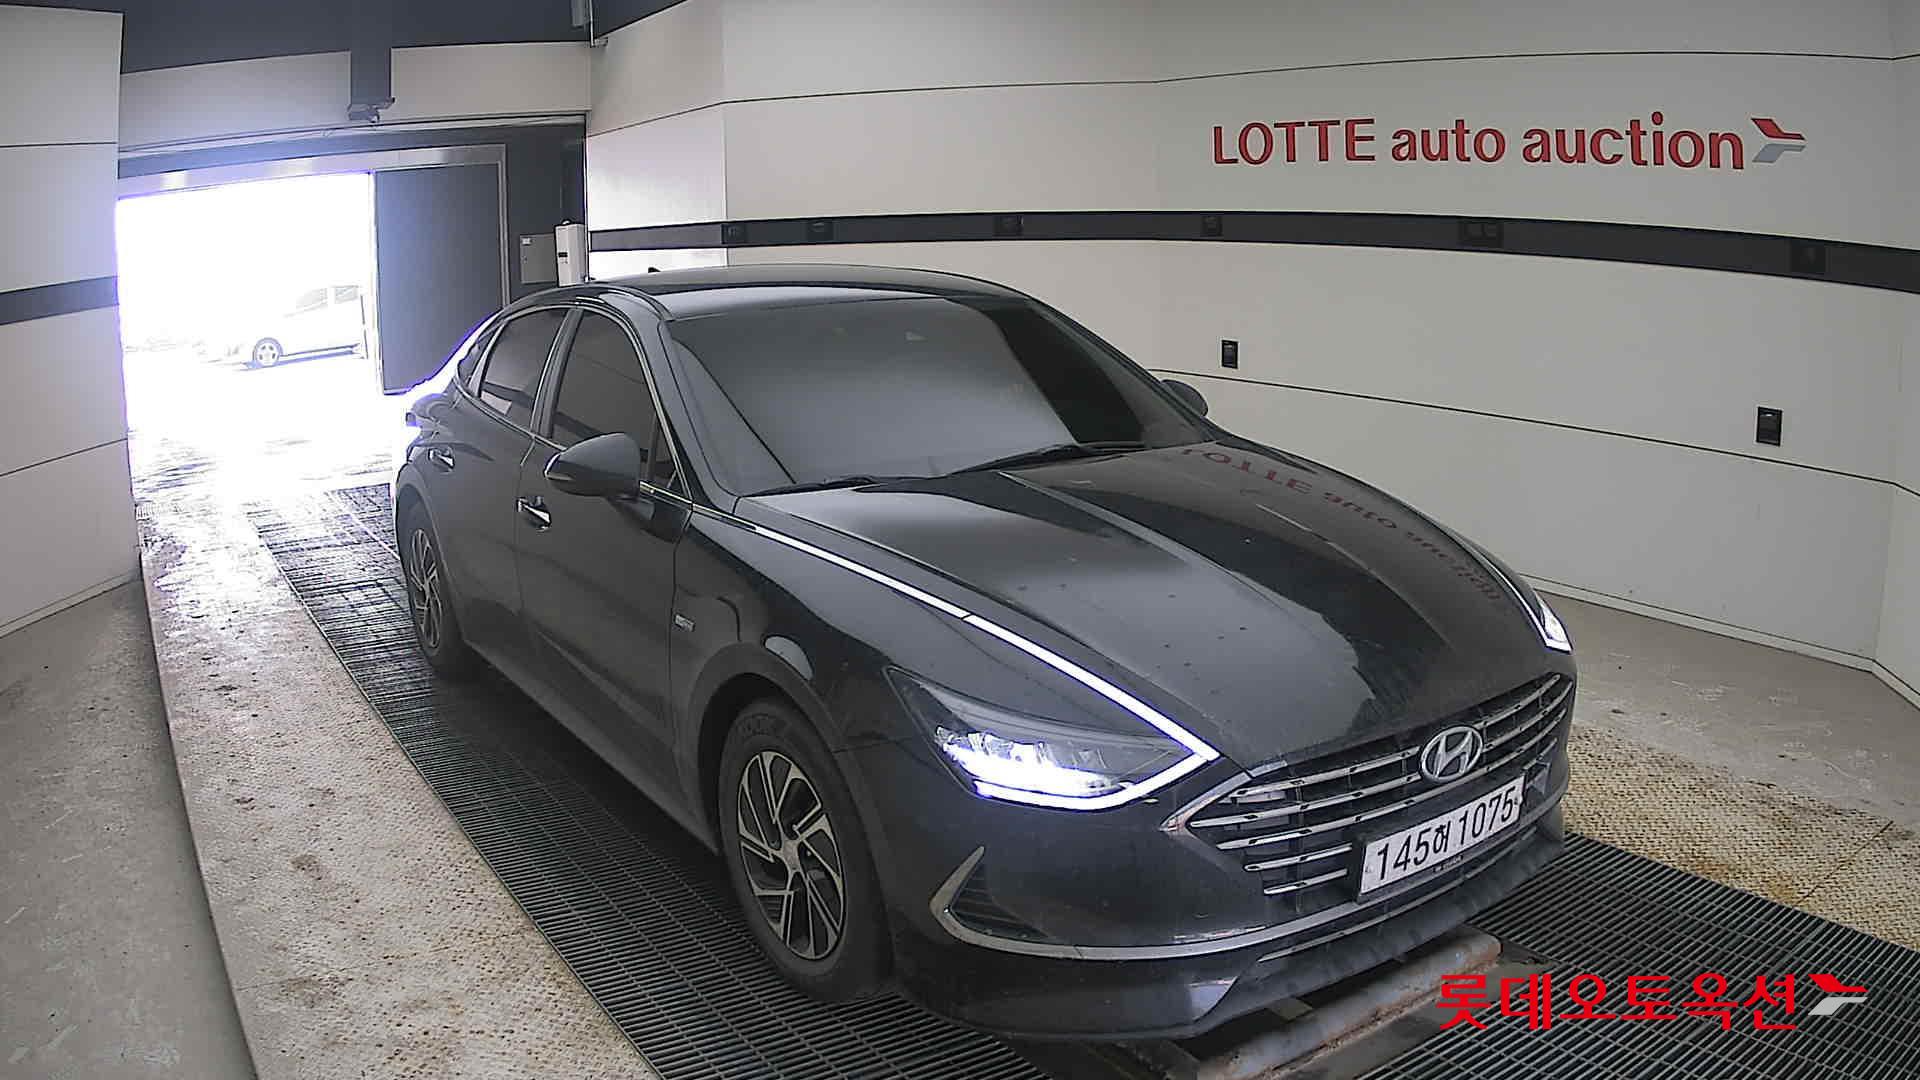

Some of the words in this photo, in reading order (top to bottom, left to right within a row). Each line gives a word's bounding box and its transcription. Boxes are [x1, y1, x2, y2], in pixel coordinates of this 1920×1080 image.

[1213, 118, 1376, 166] LOTTE
[1391, 119, 1507, 163] auto
[1522, 111, 1745, 170] auction
[1377, 820, 1452, 881] 145허
[1459, 785, 1517, 846] 1075
